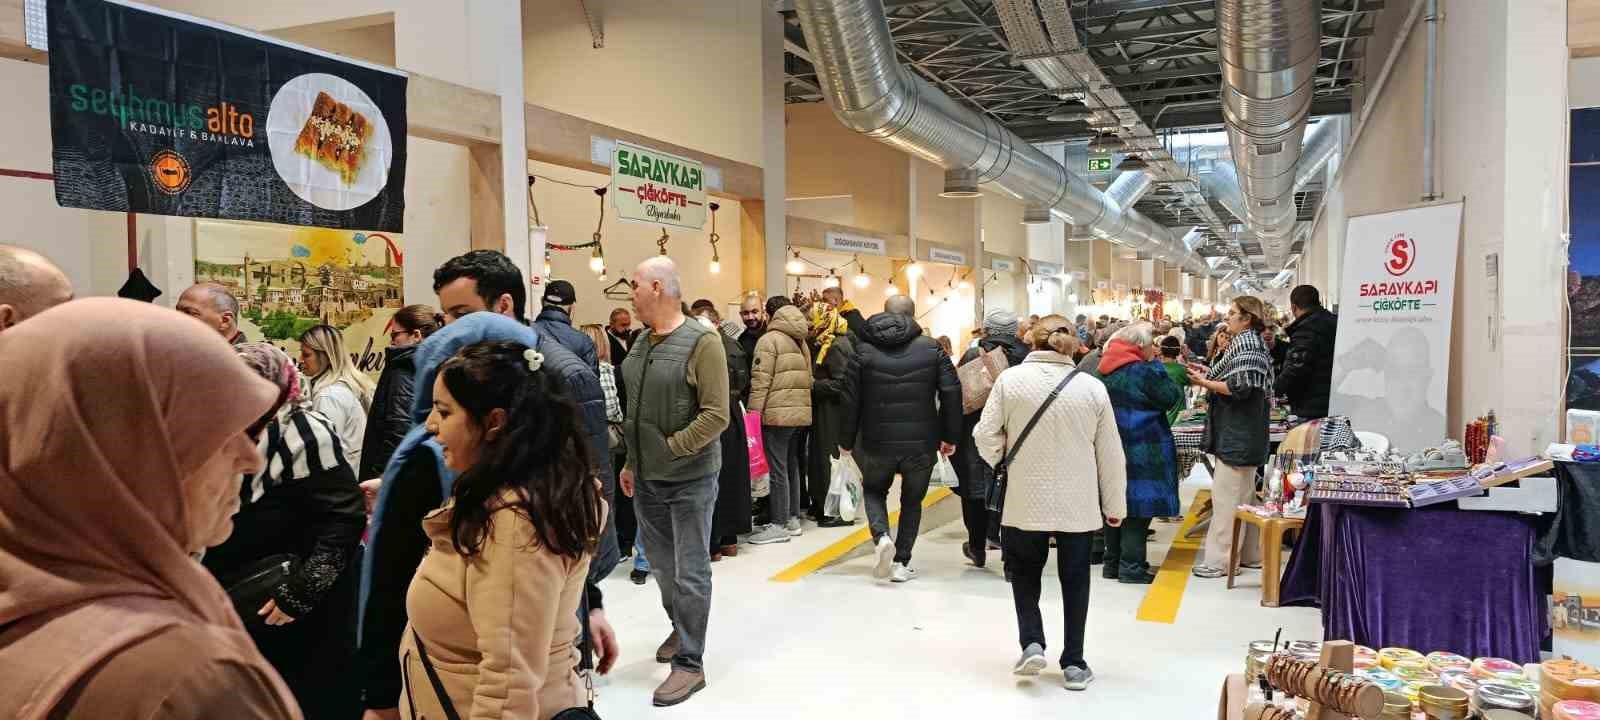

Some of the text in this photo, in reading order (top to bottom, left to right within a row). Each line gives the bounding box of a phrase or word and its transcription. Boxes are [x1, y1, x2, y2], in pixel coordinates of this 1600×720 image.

[201, 132, 255, 148] BAKLAVA
[617, 150, 703, 191] SARAYKAPI
[636, 183, 688, 207] ÇİĞKÖFTE
[1359, 280, 1439, 297] SARAYKAPI
